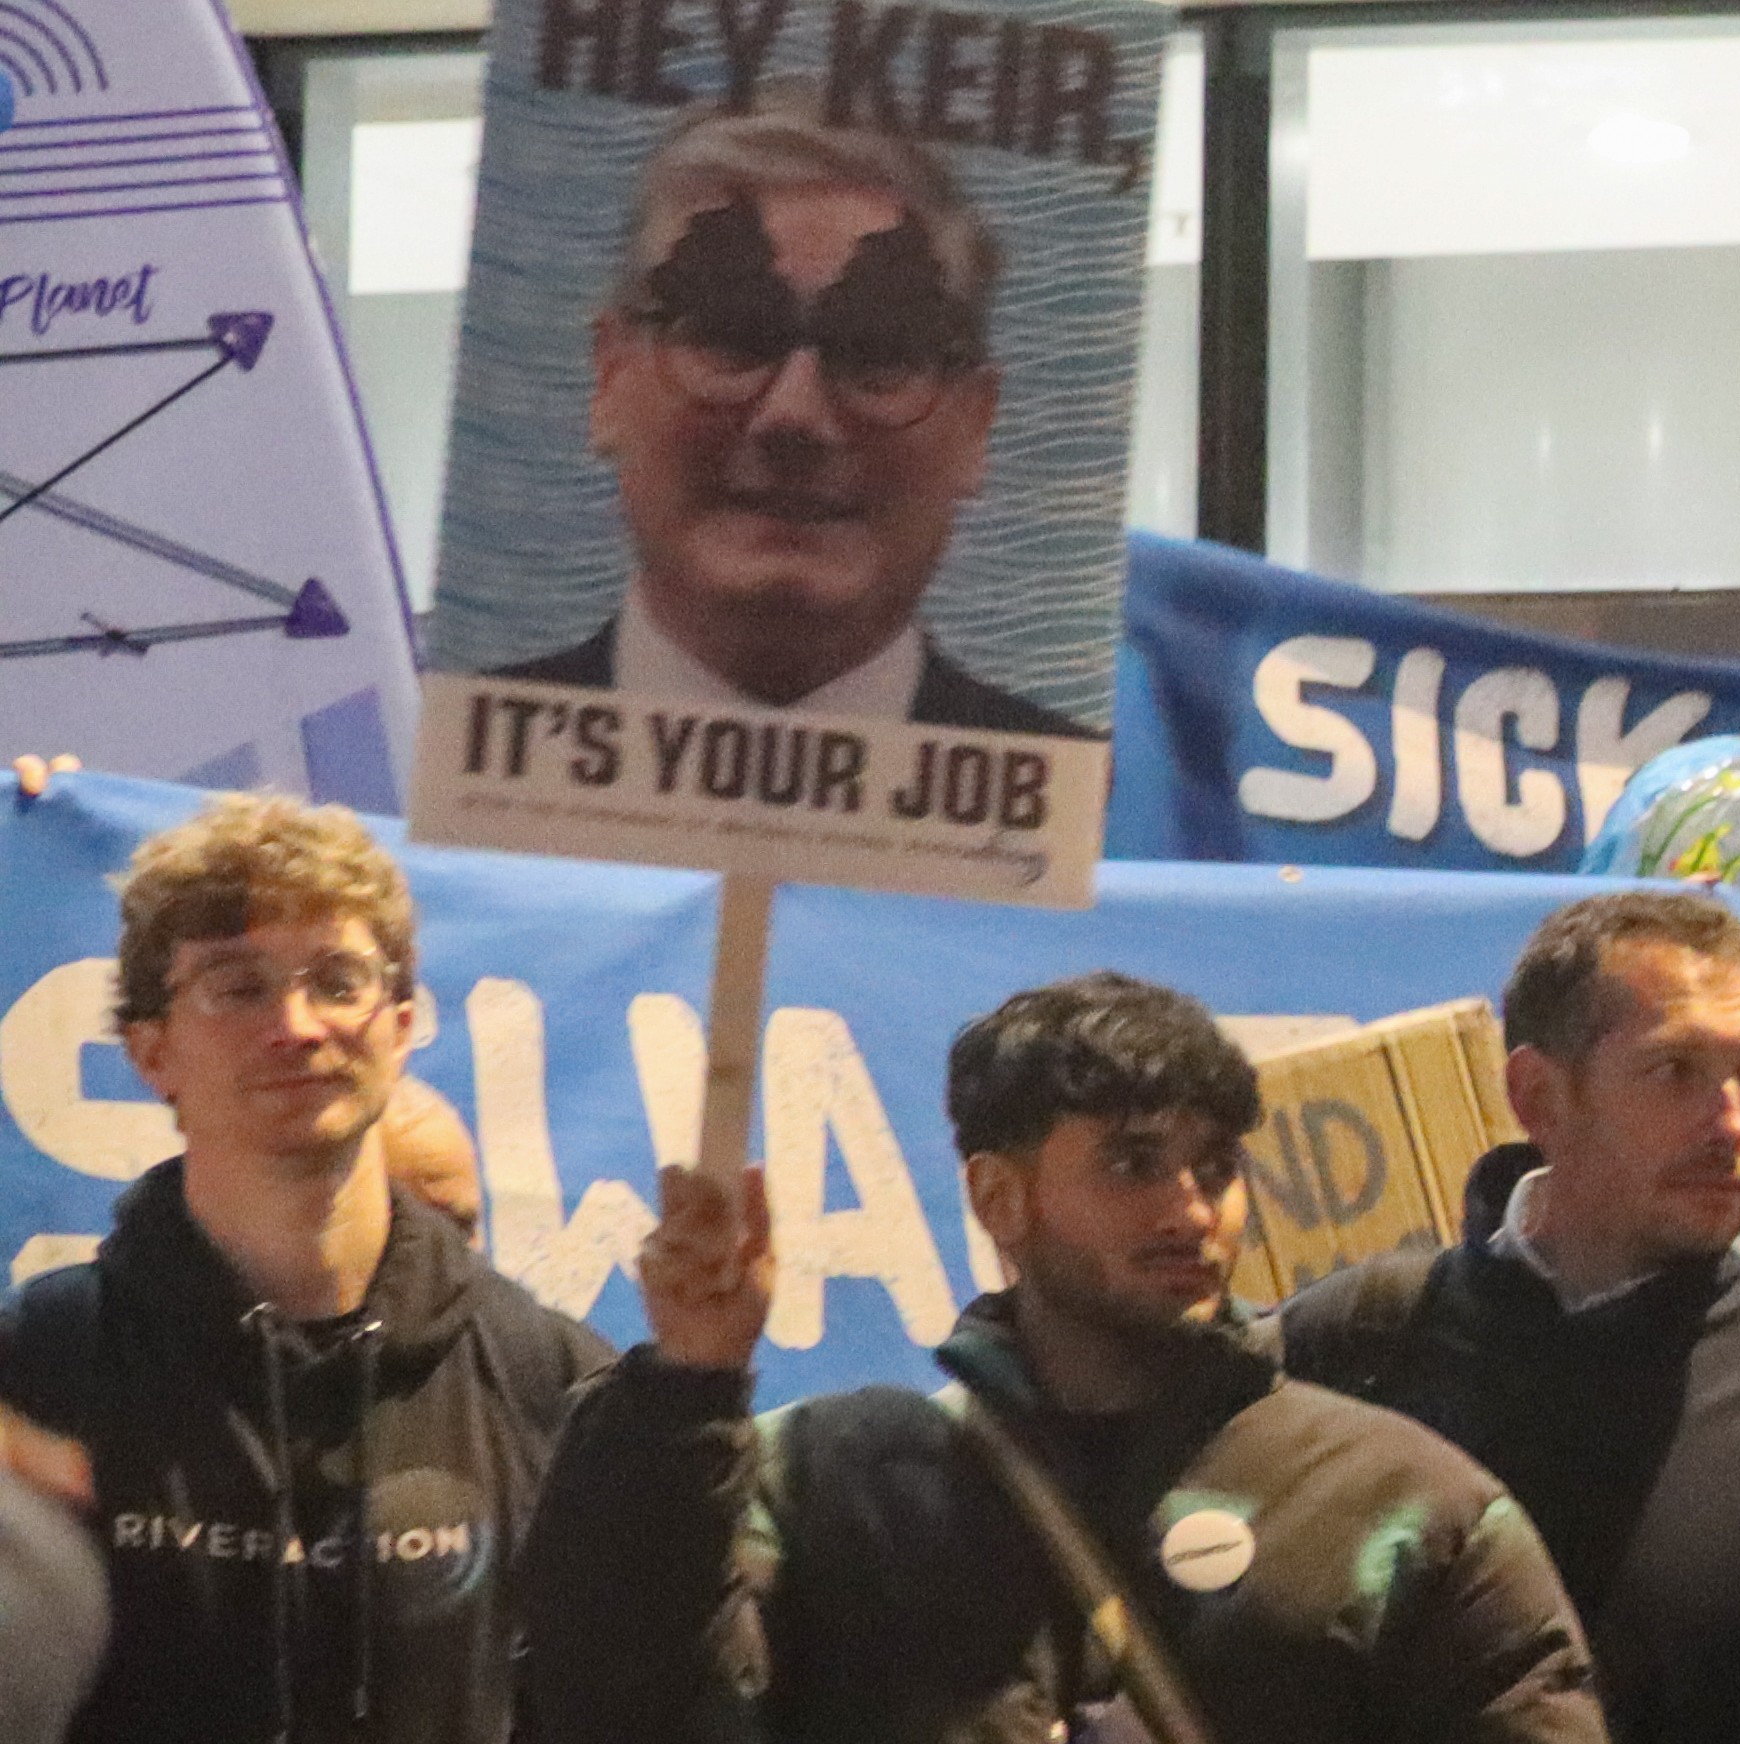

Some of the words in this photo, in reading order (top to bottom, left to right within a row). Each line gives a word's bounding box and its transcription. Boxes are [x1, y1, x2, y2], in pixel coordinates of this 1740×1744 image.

[535, 0, 788, 116] HEY
[645, 712, 869, 813] YOUR
[887, 738, 1055, 832] JOB
[1236, 634, 1713, 860] SICK
[1250, 1093, 1388, 1246] ND
